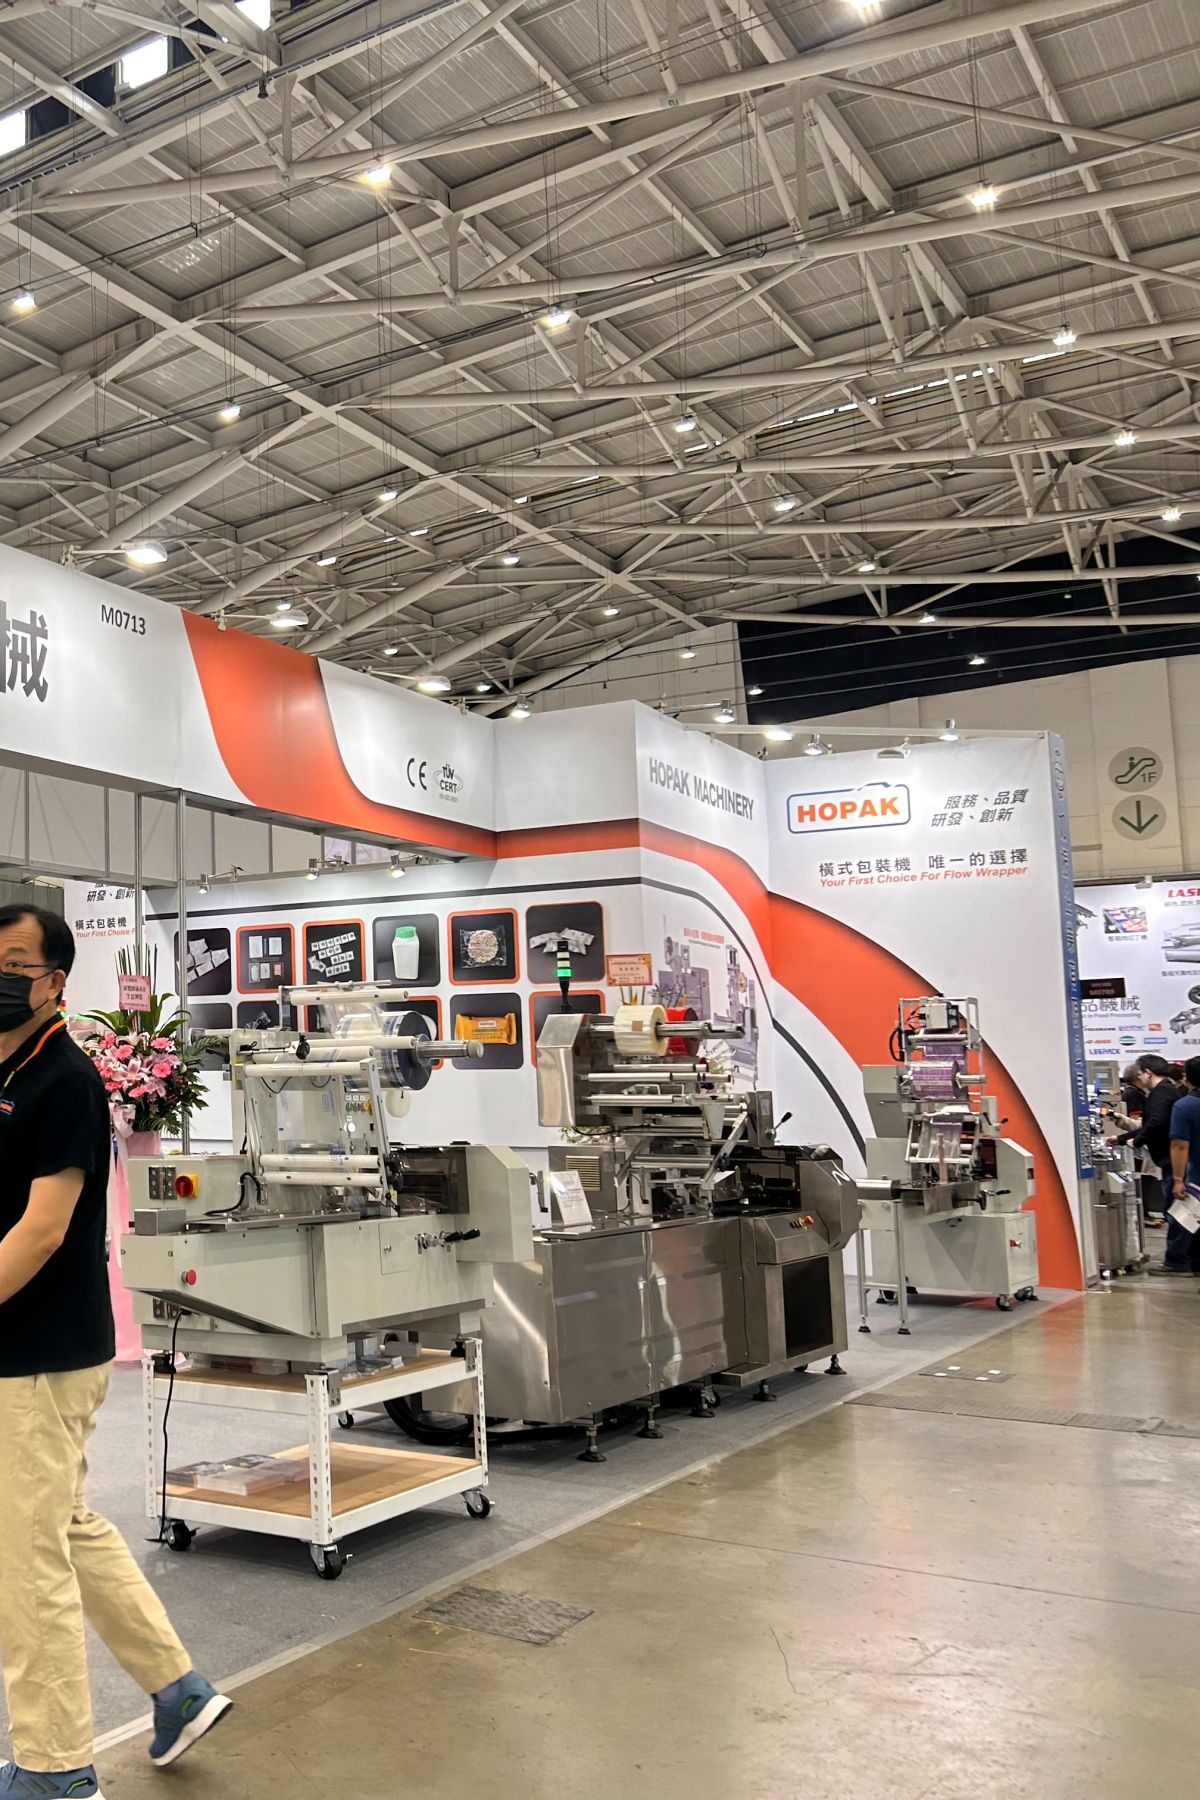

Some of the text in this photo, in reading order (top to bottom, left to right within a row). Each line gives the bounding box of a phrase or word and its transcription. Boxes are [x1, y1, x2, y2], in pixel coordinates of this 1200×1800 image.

[101, 604, 146, 635] M0713
[440, 779, 457, 793] CERT
[1141, 772, 1157, 783] 1F
[649, 757, 754, 820] HOPAK MACHINERY
[944, 788, 1029, 810] 服務、品質
[796, 796, 901, 824] HOPAK
[931, 807, 1015, 828] 研發、創新
[819, 848, 1028, 877] 橫式包裝機 唯一的選擇
[820, 866, 1028, 888] Your First Choice For Flow Wrapper
[1167, 887, 1200, 898] LAS
[75, 917, 127, 931] 橫式包裝機
[108, 927, 130, 936] Choice
